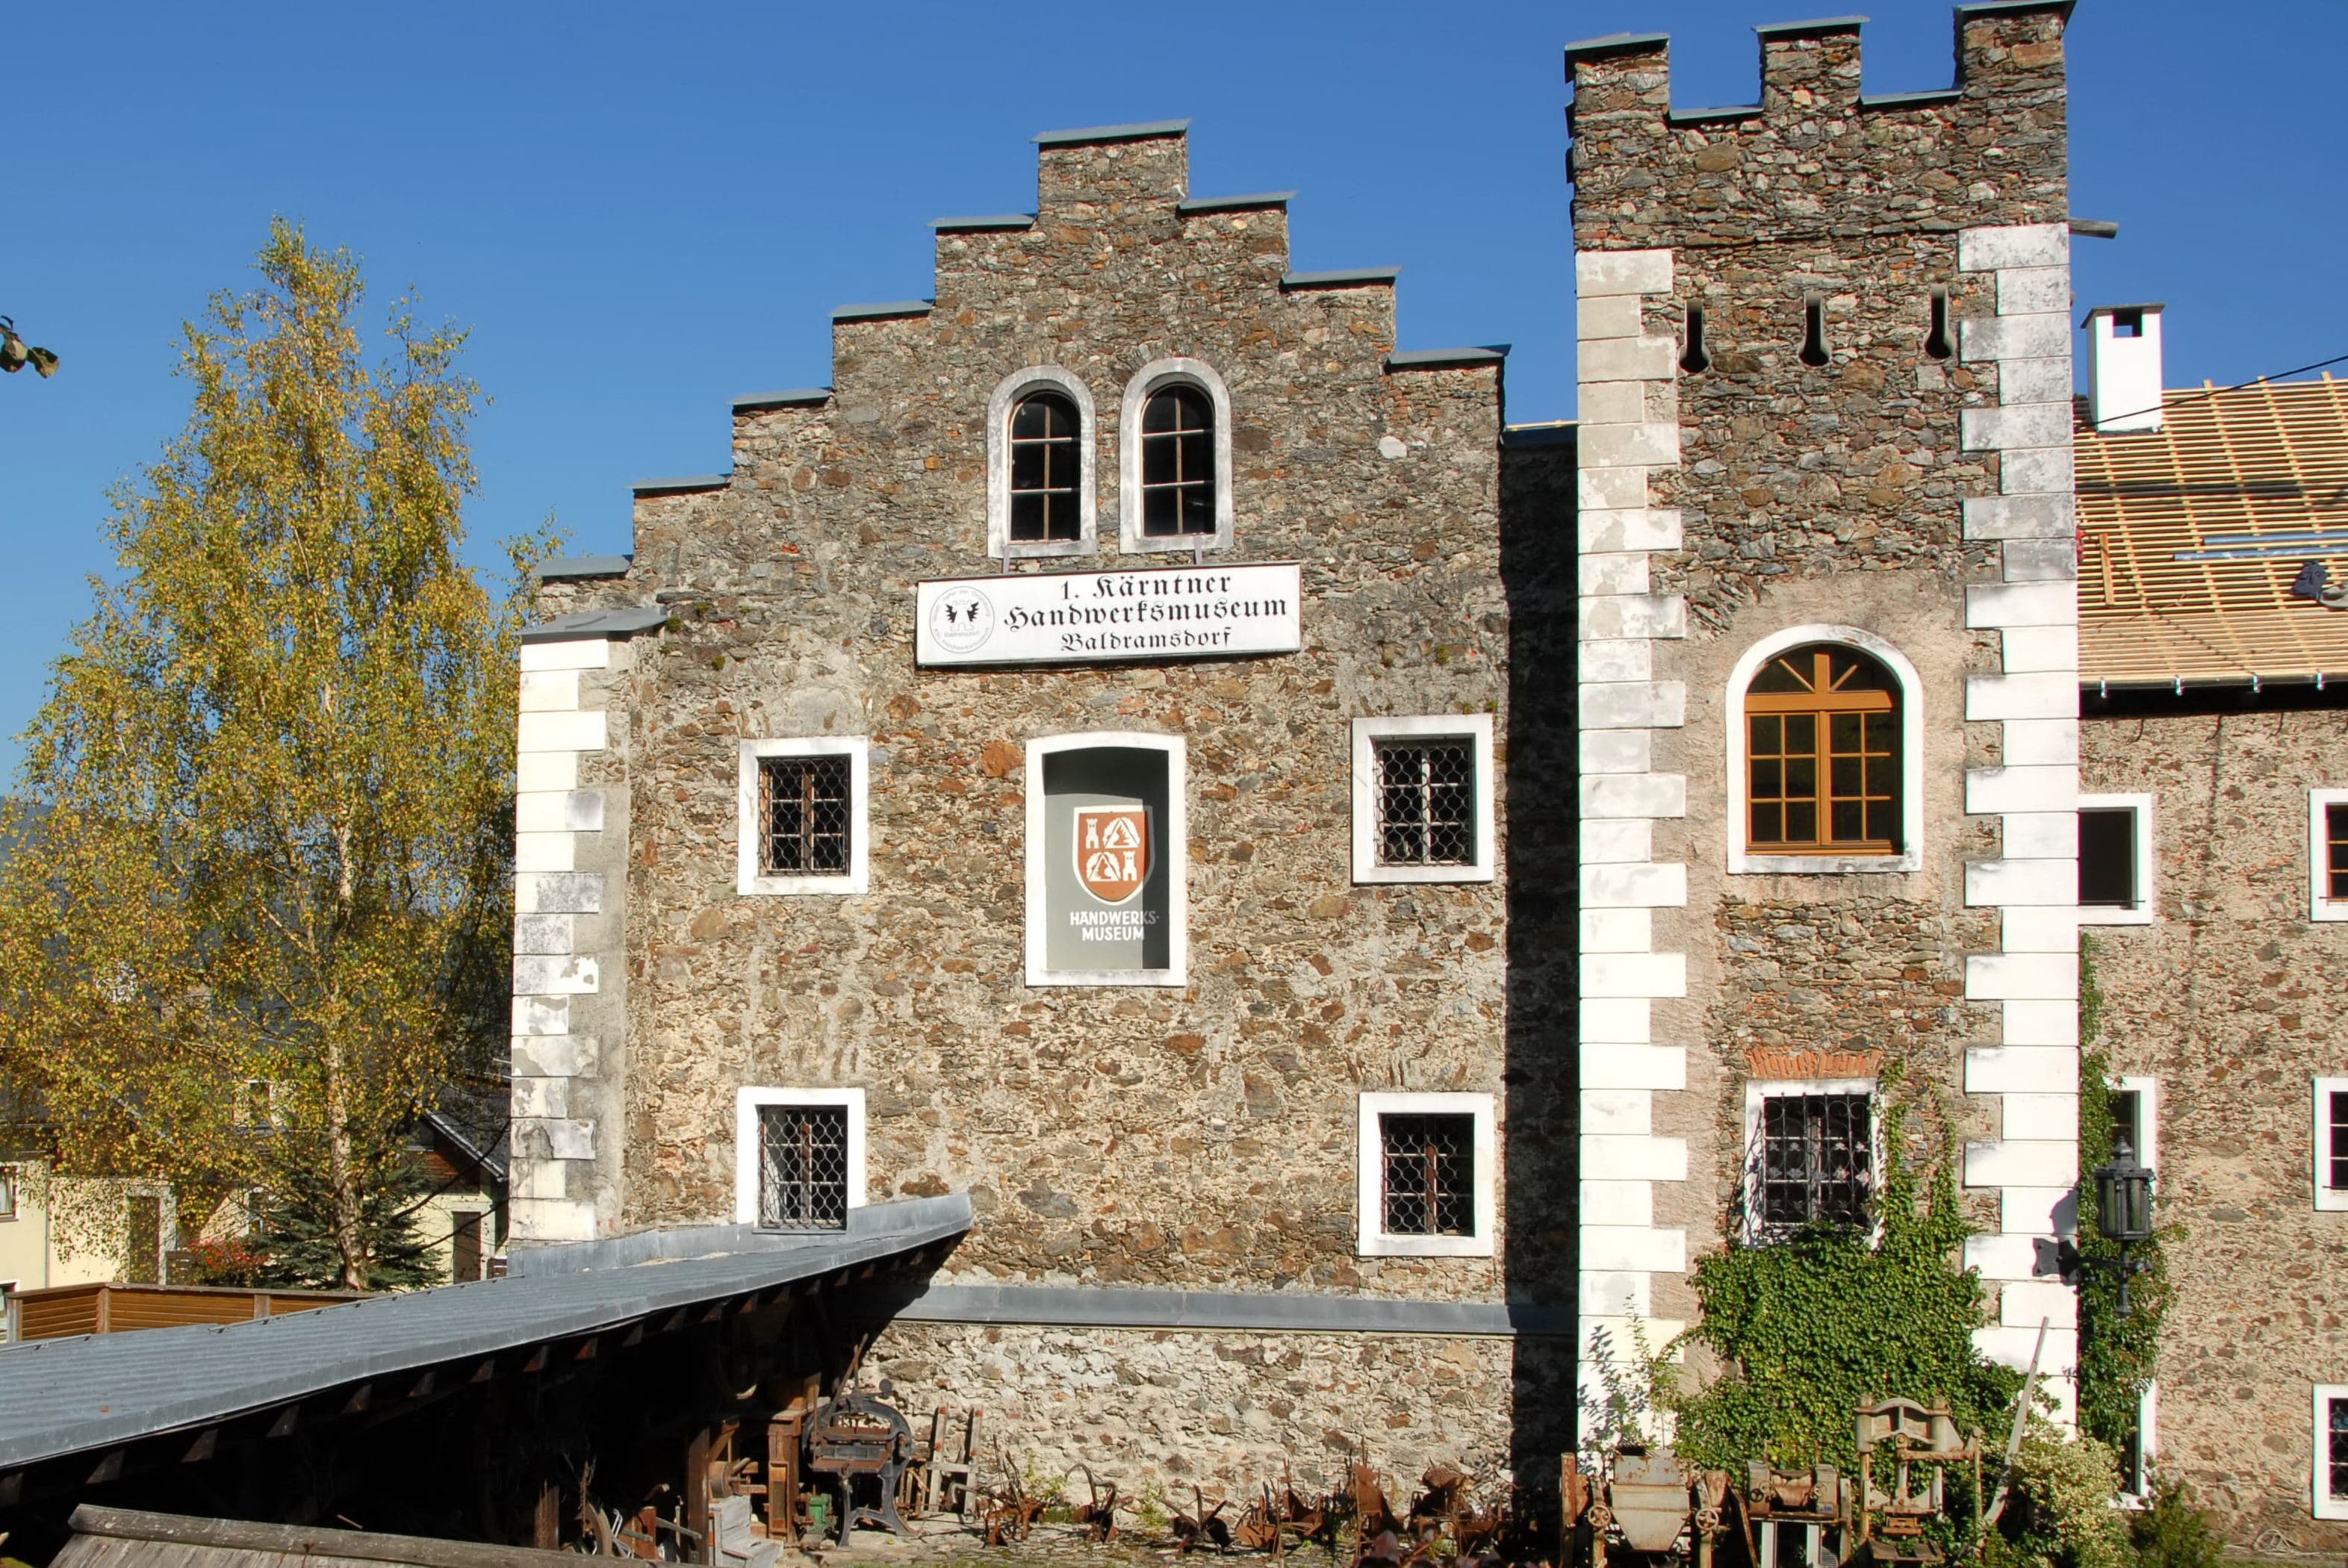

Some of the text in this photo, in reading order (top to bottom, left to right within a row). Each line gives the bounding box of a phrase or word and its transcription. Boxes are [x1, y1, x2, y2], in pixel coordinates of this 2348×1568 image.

[1060, 575, 1232, 600] 1. Kärntner
[1004, 598, 1287, 632] Handwerksmuseum
[1060, 626, 1232, 652] Baldramsdorf
[1082, 927, 1144, 942] MUSEUM
